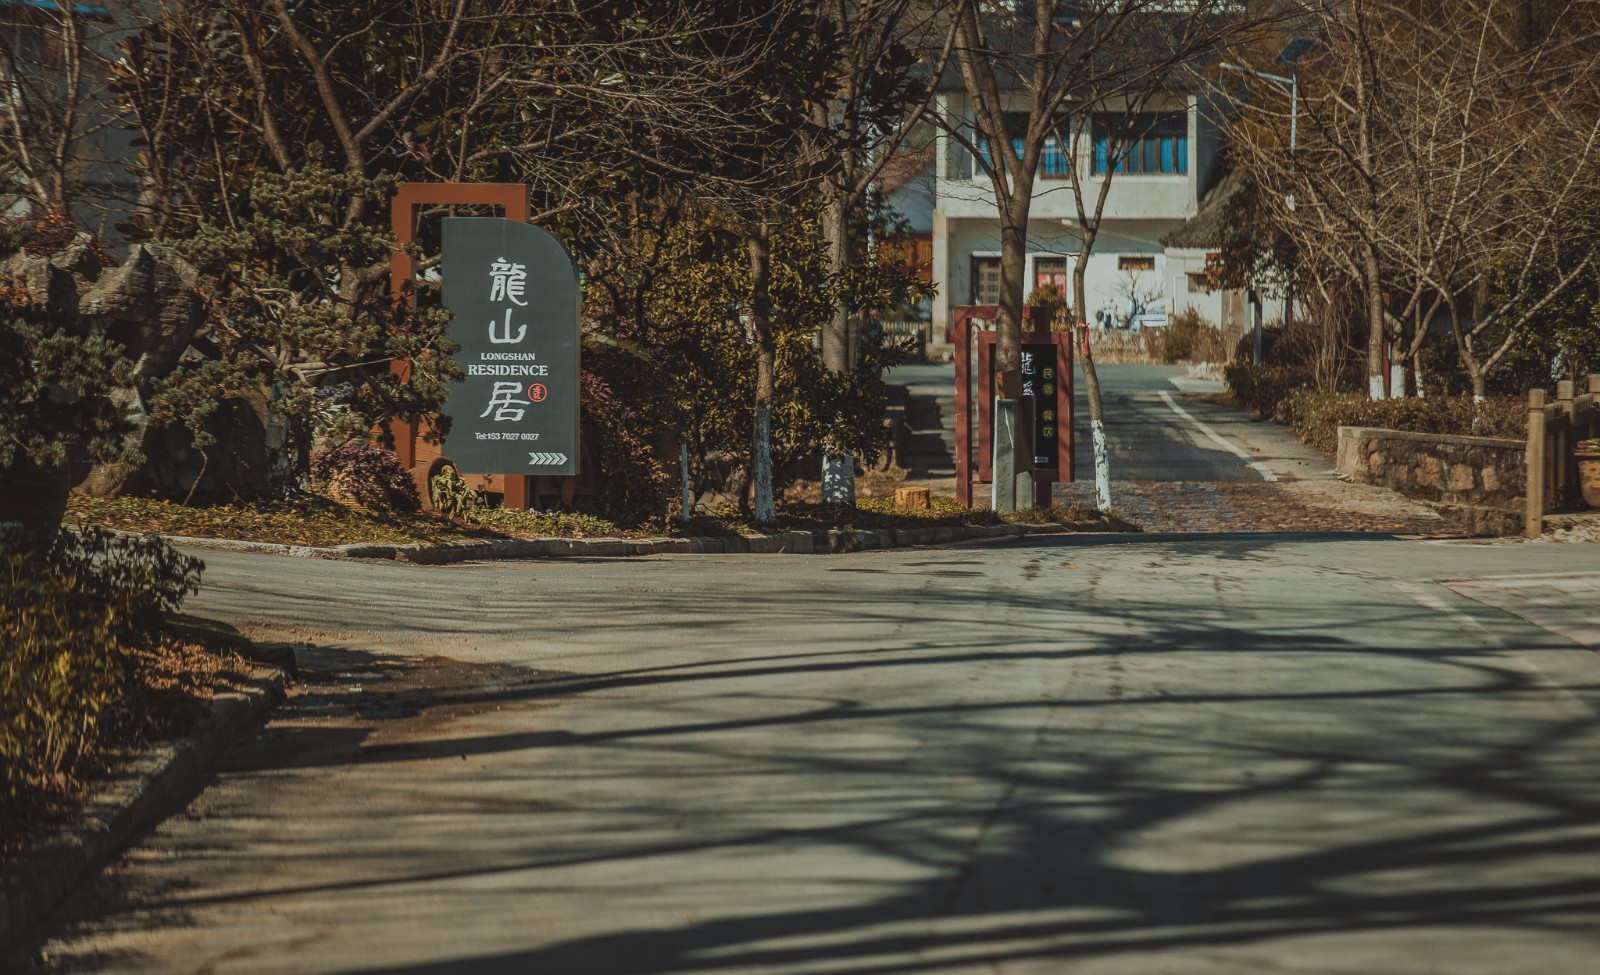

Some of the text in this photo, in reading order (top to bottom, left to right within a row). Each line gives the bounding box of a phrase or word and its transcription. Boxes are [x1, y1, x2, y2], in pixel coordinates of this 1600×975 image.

[480, 352, 536, 361] LONGSHAN
[467, 364, 549, 376] RESIDENCE
[501, 432, 520, 441] 7027
[520, 433, 540, 441] 0027
